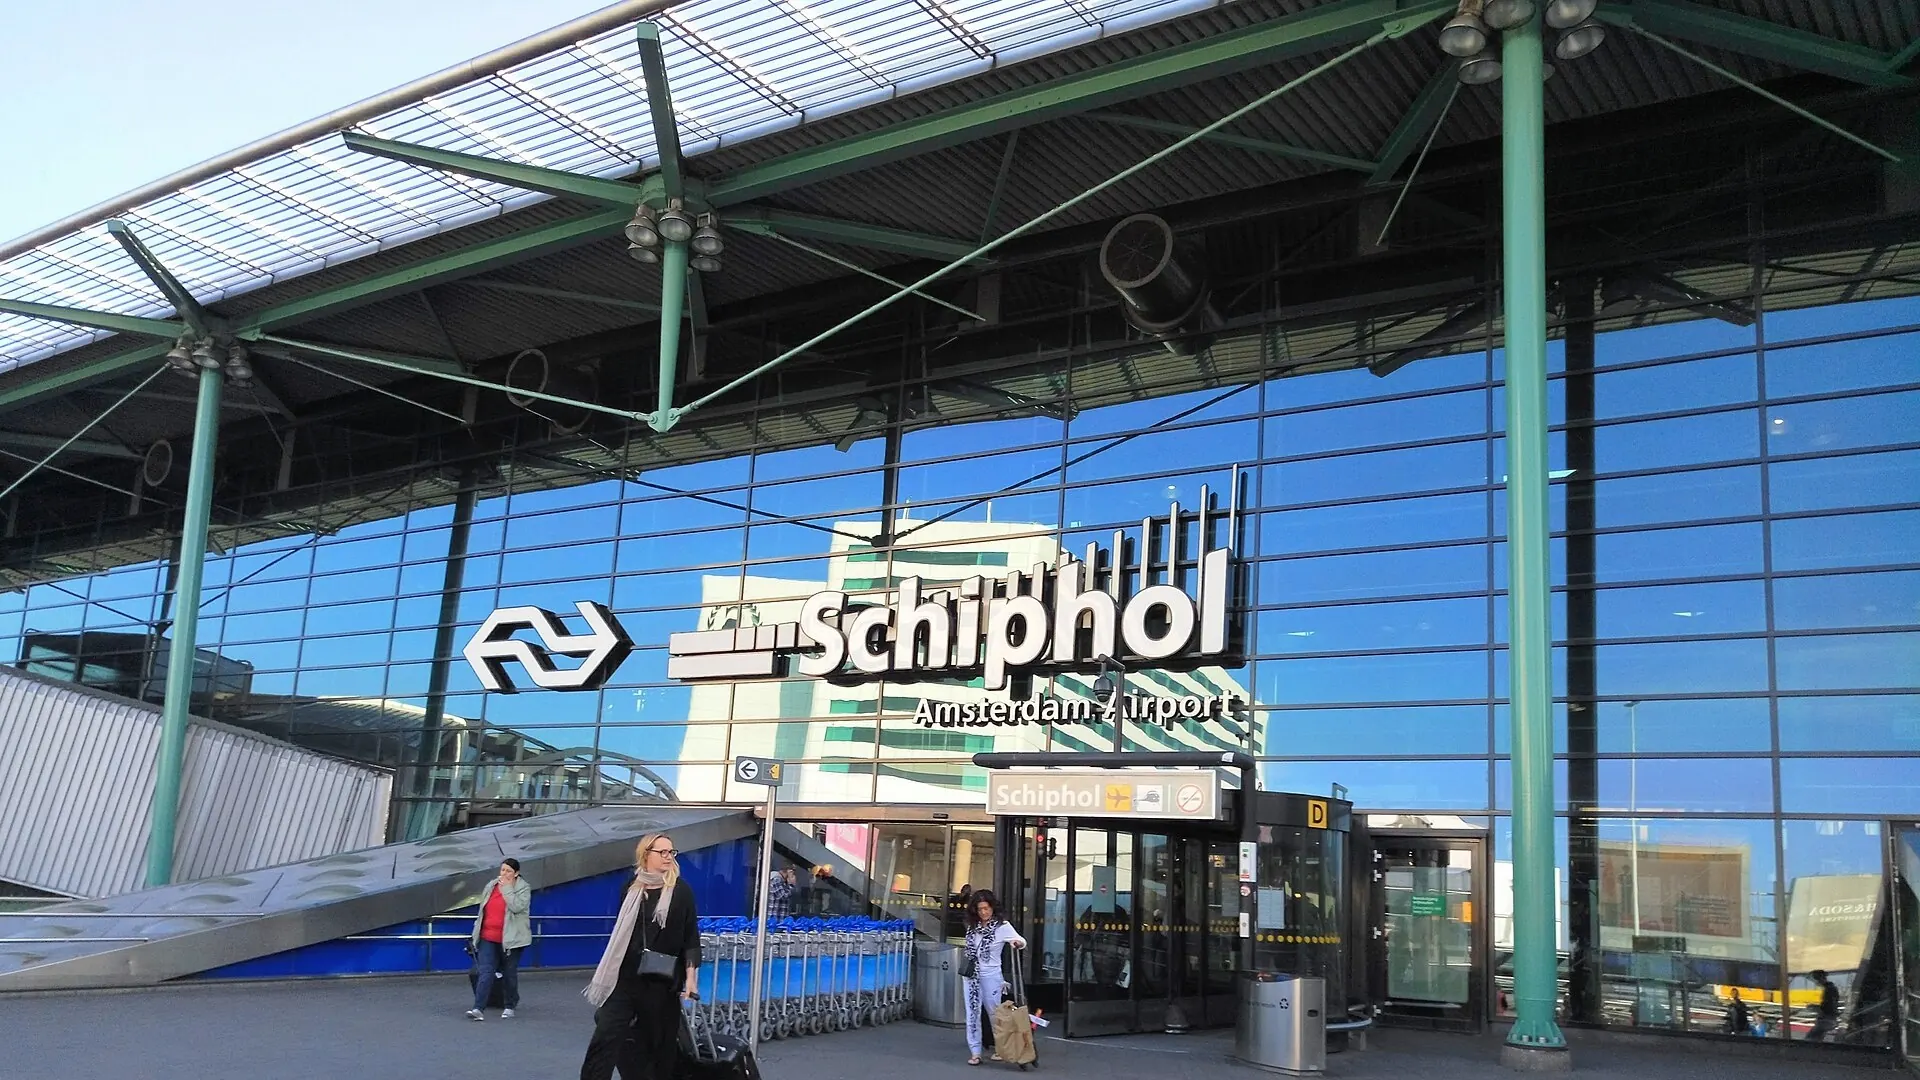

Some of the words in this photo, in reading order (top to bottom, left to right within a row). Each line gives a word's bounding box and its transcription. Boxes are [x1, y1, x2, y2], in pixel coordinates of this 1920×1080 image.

[798, 547, 1230, 690] Schiphol
[911, 692, 1091, 725] Amsterdam
[1101, 687, 1235, 727] Airport
[996, 783, 1101, 811] Schiphol
[1312, 803, 1324, 824] D
